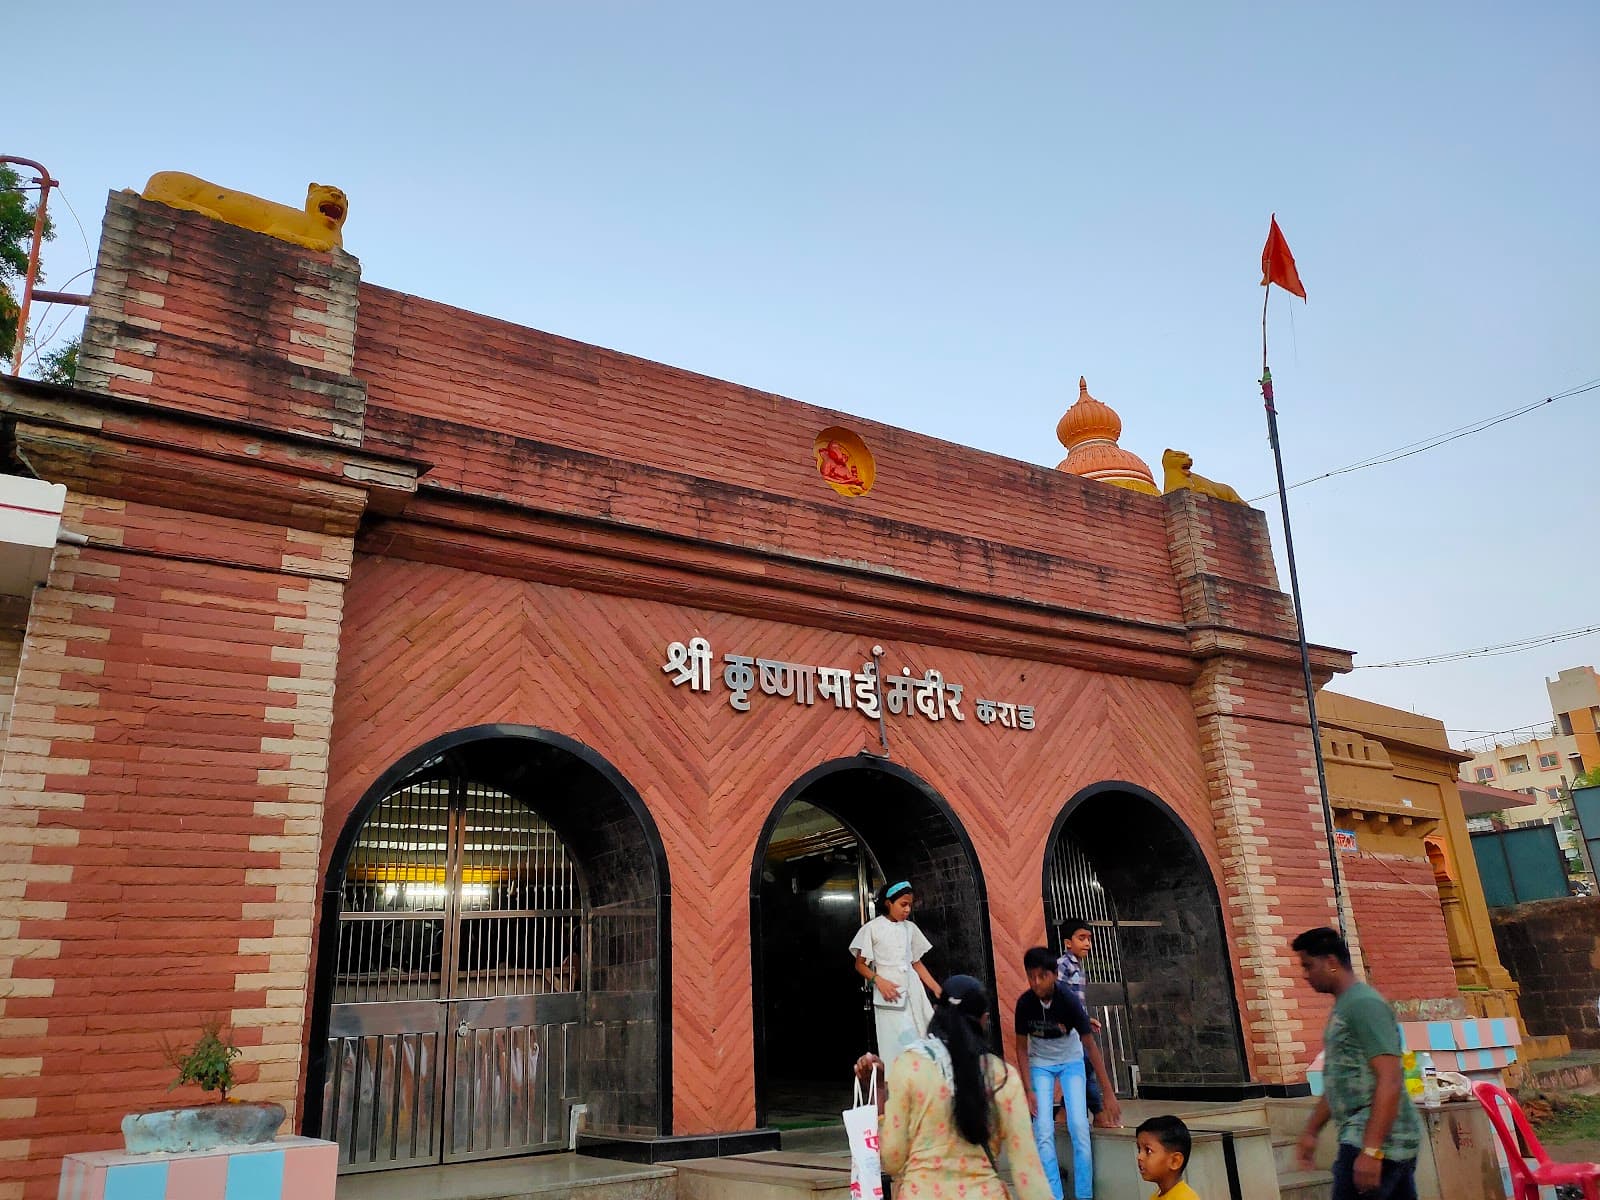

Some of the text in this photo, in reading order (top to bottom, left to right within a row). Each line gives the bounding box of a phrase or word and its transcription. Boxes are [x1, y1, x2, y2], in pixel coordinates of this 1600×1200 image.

[663, 637, 713, 692] श्री
[886, 666, 965, 721] मंदीर
[975, 698, 1036, 730] कराड
